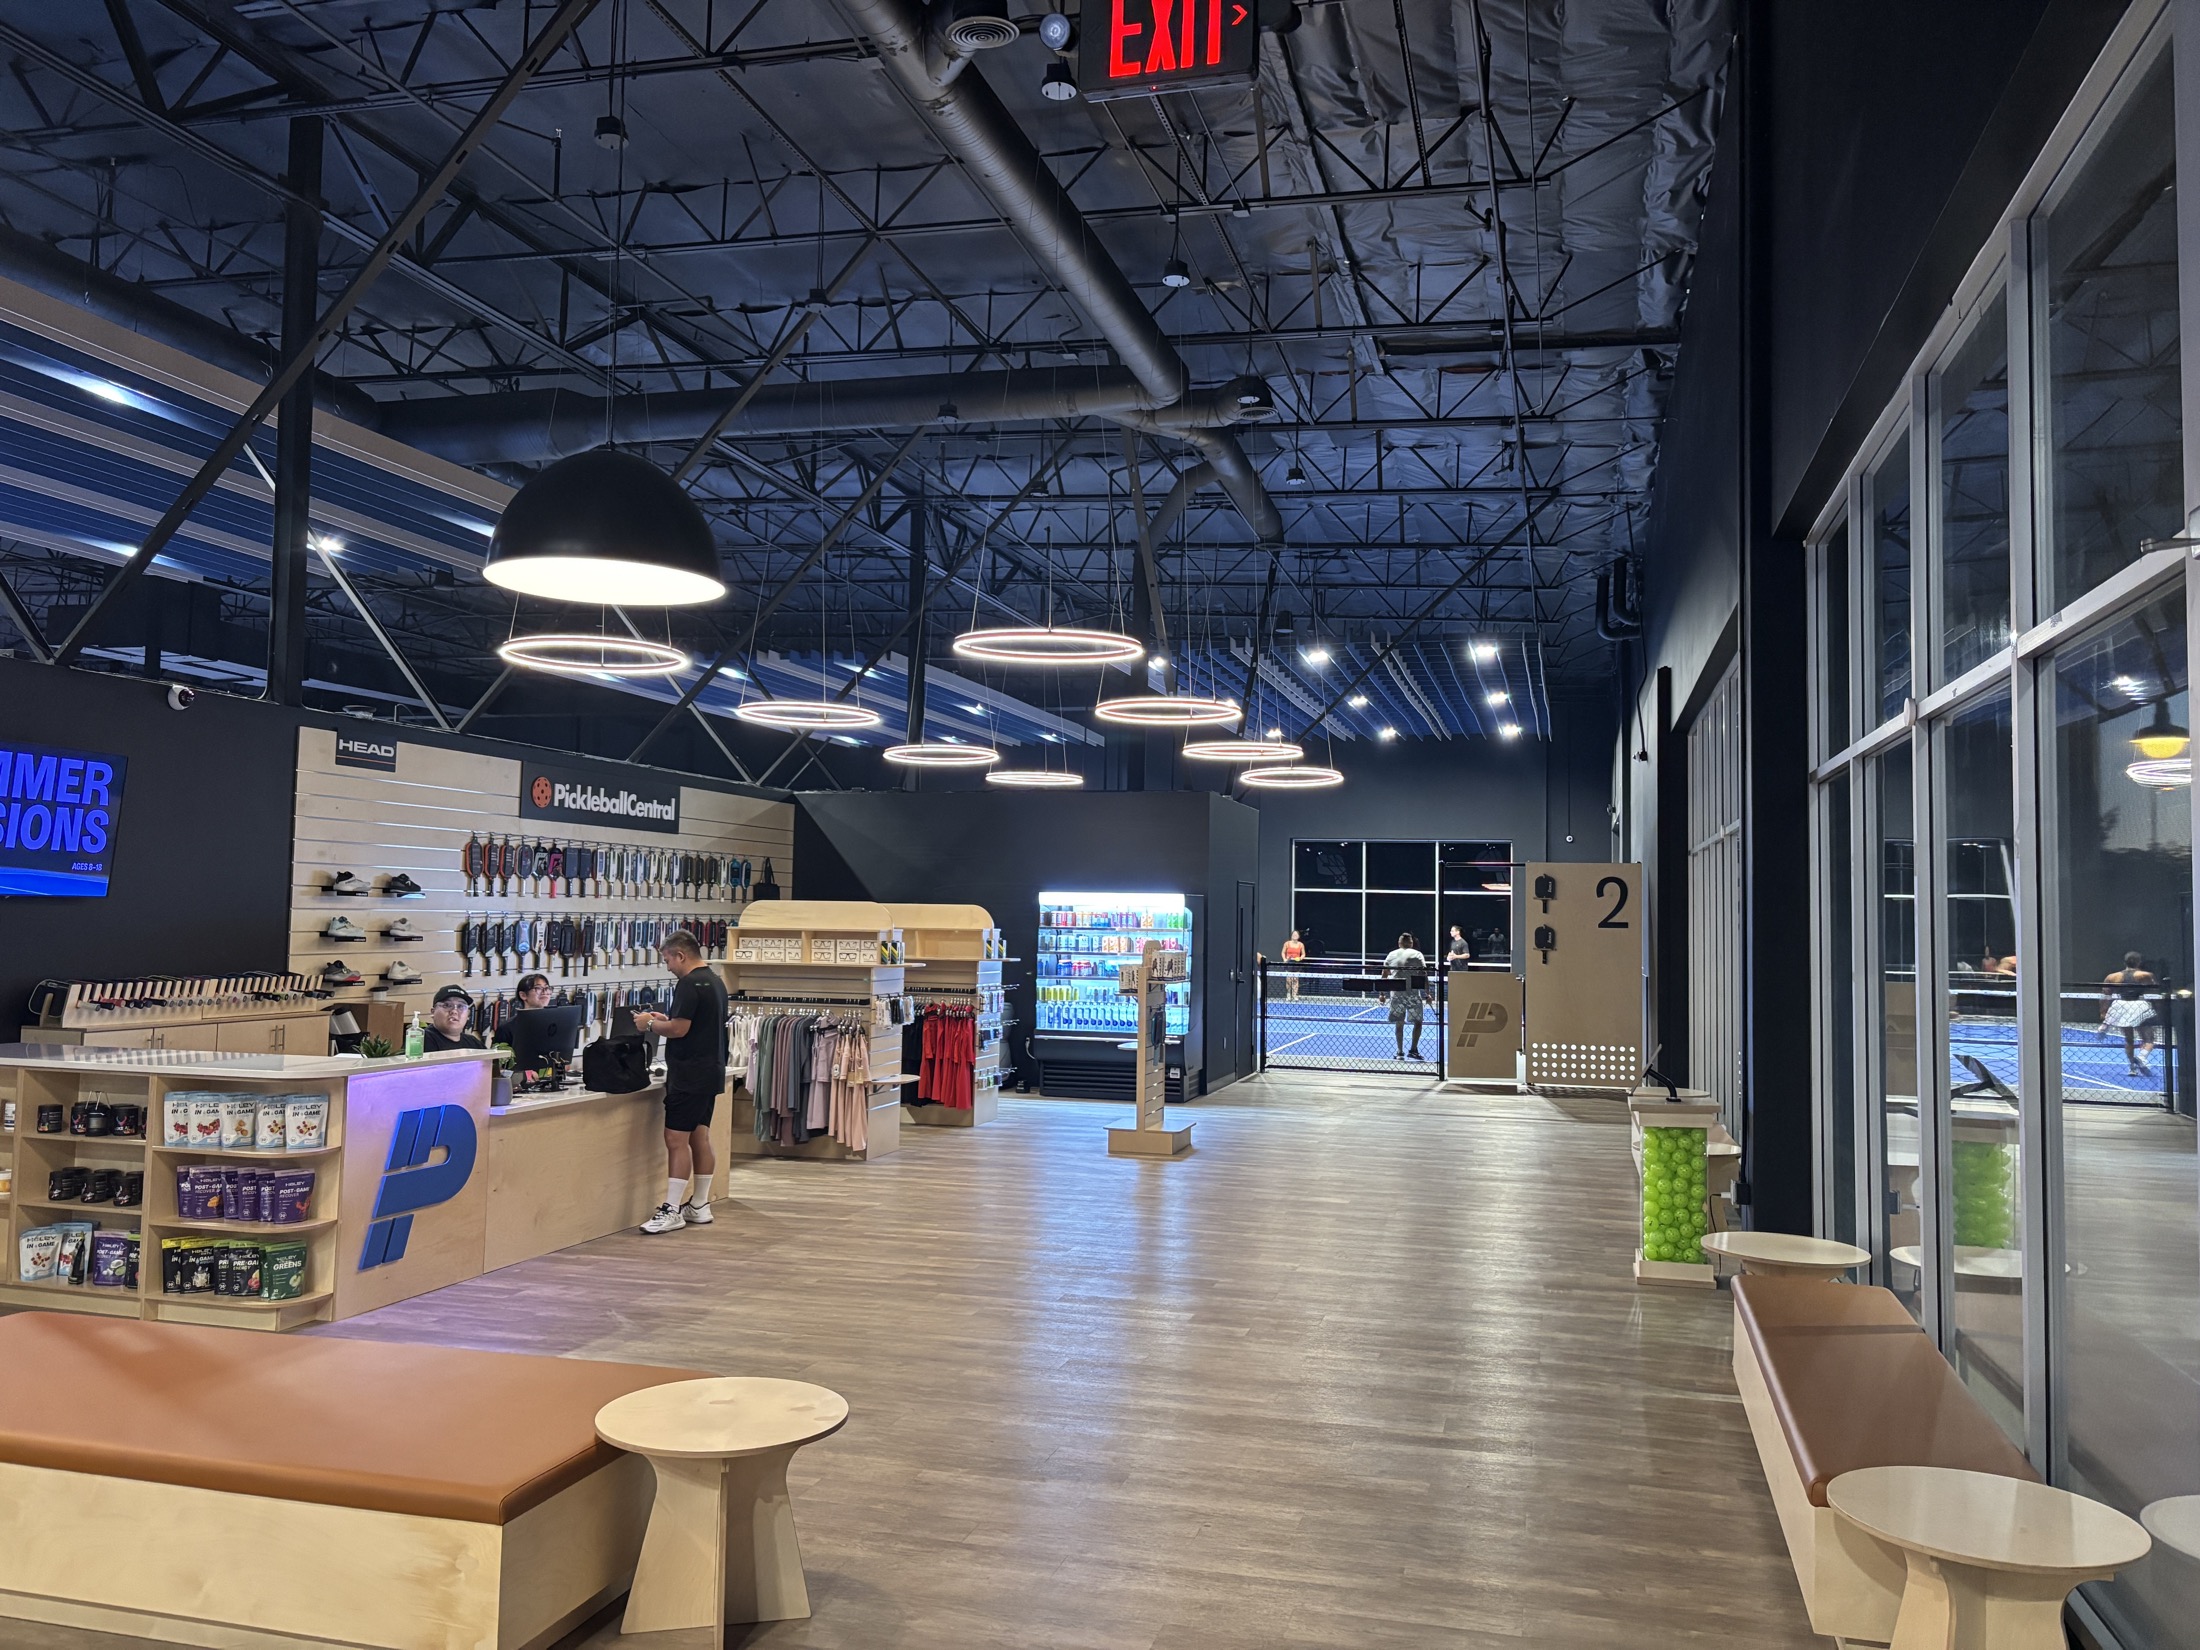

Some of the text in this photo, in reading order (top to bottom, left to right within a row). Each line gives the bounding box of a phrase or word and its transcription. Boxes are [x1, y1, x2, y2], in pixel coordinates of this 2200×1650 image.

[1109, 0, 1222, 78] EXIT
[338, 739, 395, 758] HEAD
[0, 751, 114, 806] MER
[553, 783, 676, 821] PickleballCentral
[0, 802, 110, 854] IONS
[72, 862, 88, 871] AGES
[1596, 876, 1629, 928] 2
[273, 1260, 302, 1271] GREENS
